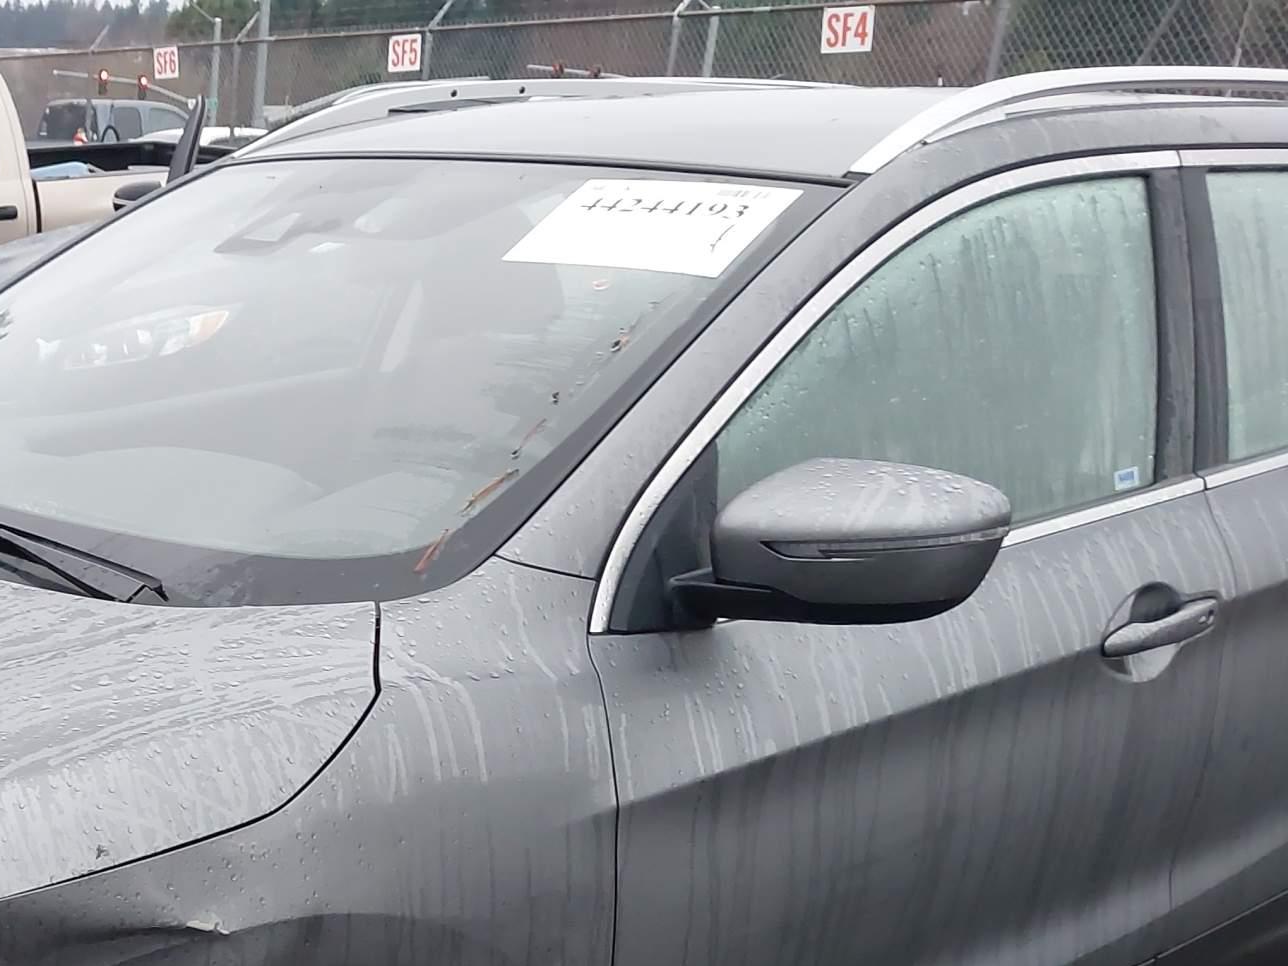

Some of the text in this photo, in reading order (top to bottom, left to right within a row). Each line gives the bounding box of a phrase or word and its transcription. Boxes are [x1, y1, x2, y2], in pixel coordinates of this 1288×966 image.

[826, 12, 869, 48] SF4
[157, 51, 177, 75] SF6
[392, 39, 417, 67] SF5
[580, 198, 750, 220] 44244193
